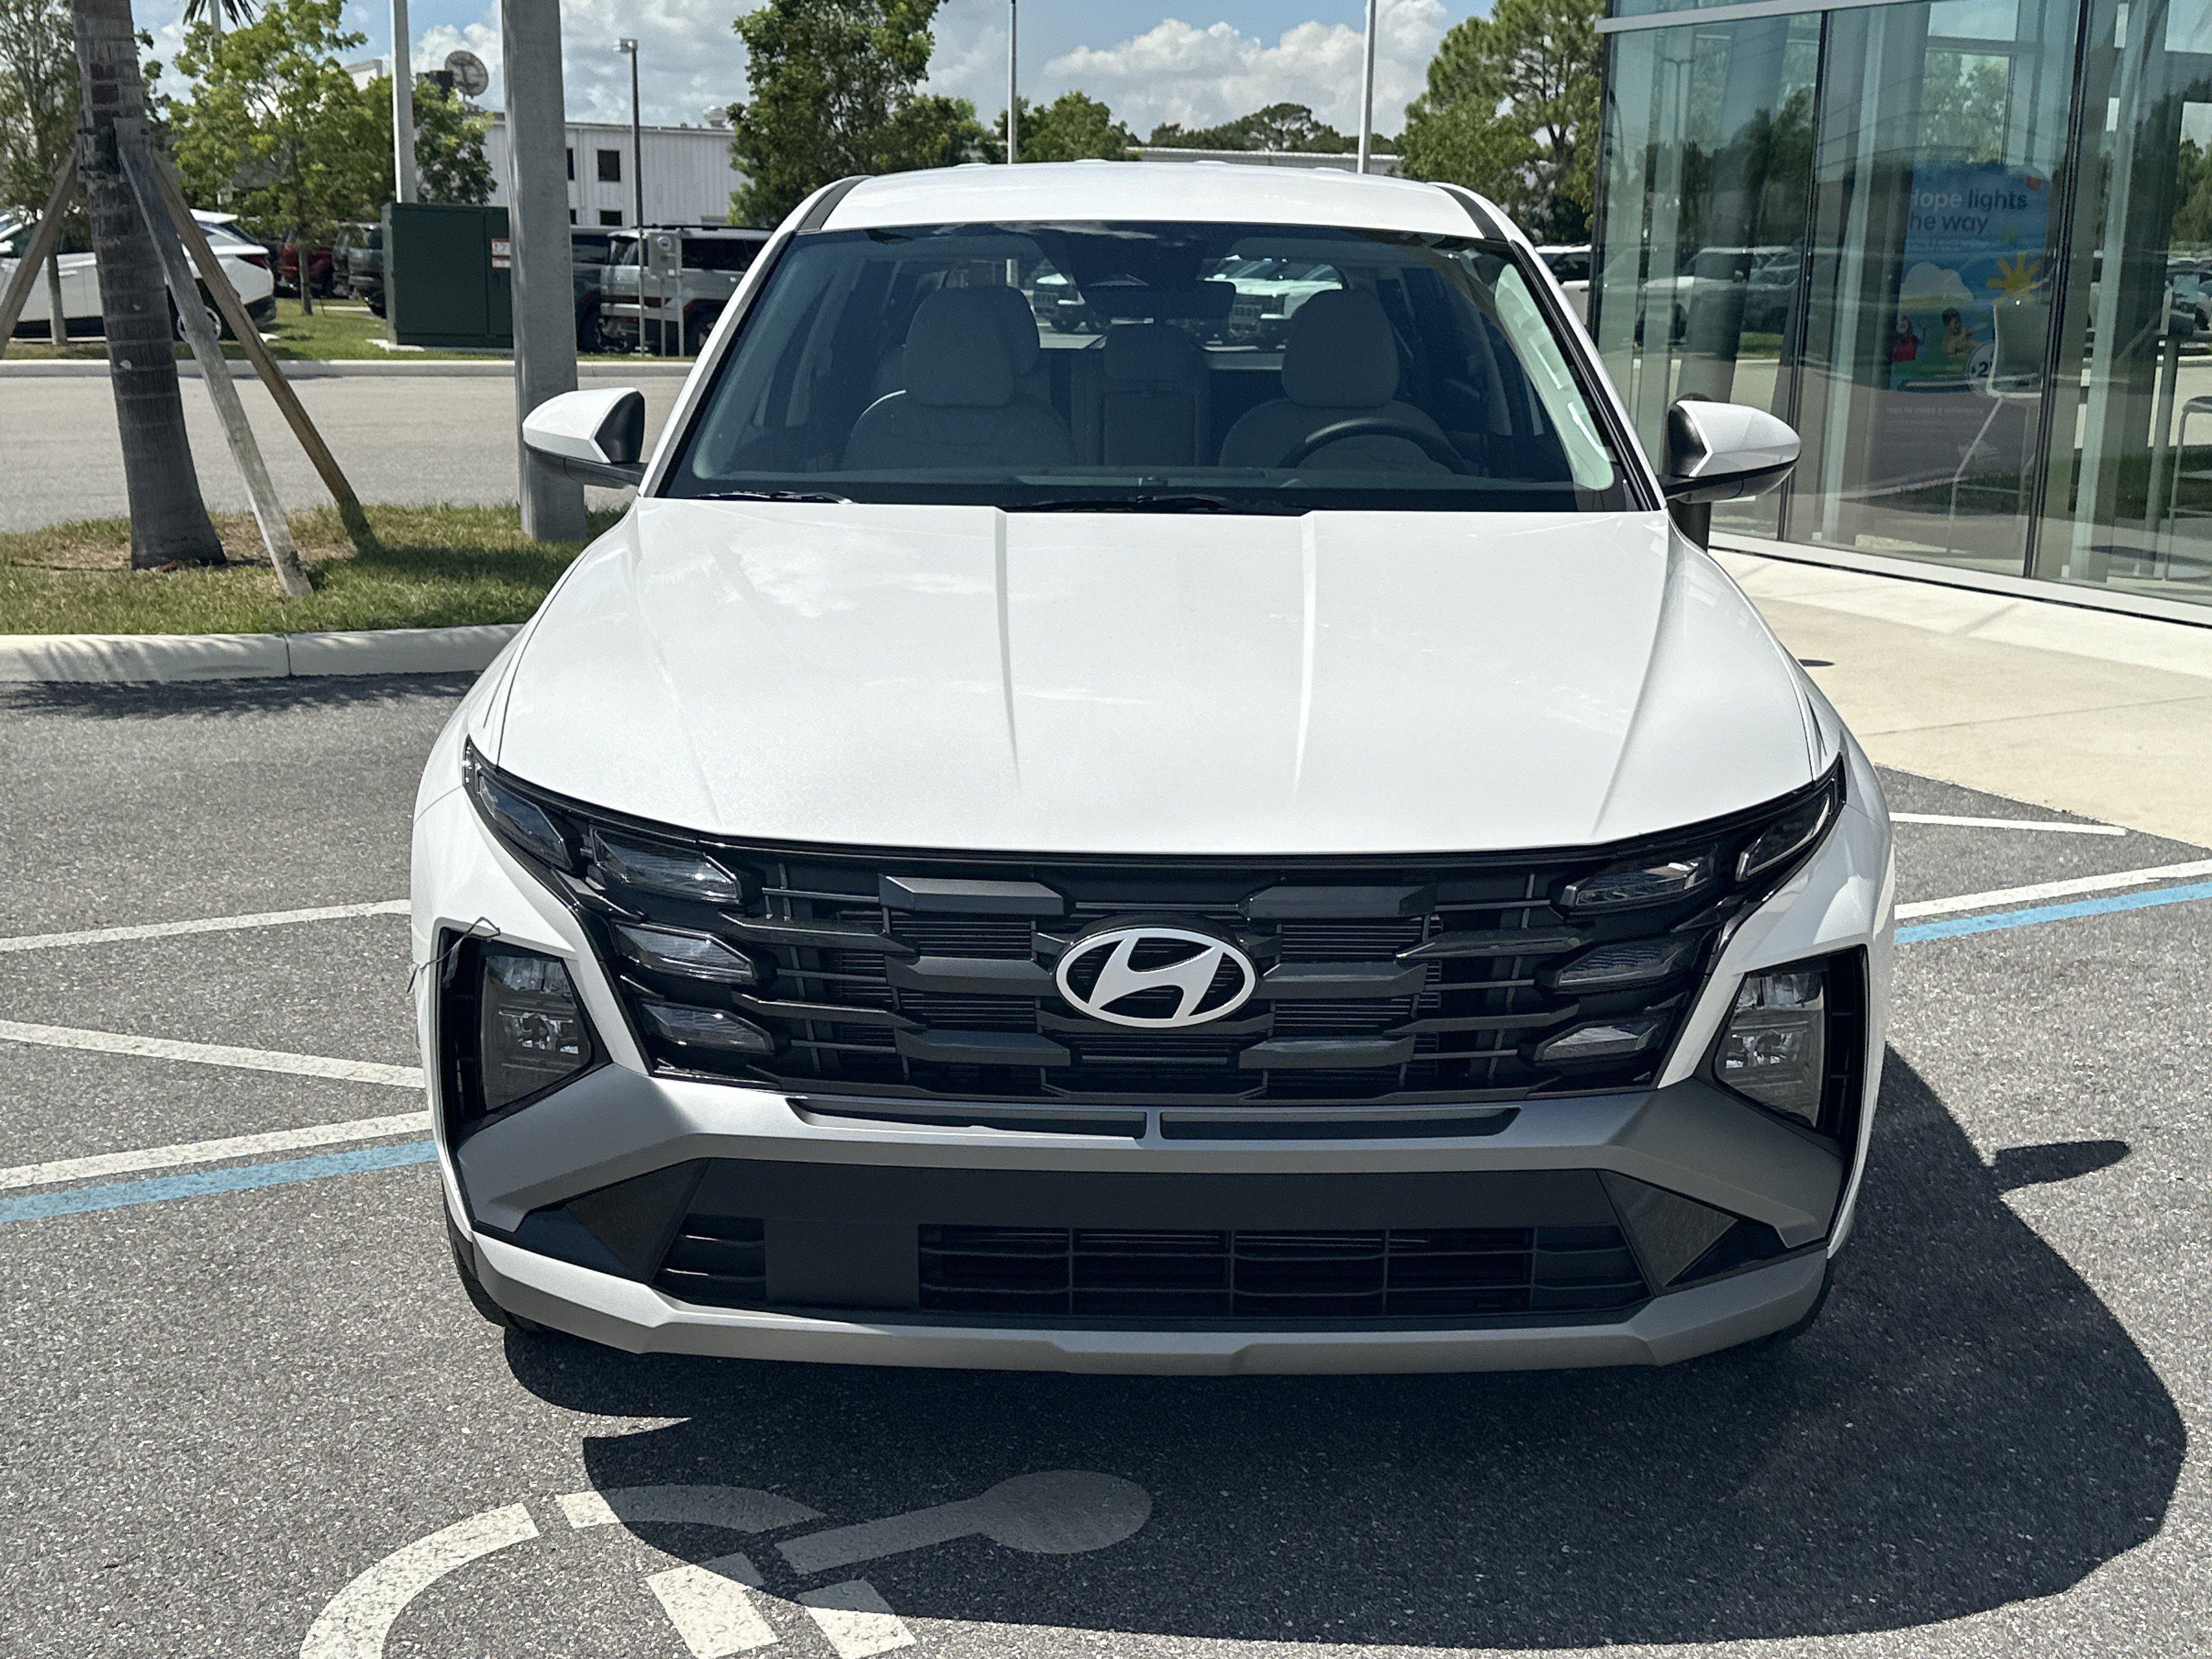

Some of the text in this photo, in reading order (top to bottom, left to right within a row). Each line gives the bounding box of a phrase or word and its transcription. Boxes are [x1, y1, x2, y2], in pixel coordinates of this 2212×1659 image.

[1968, 188, 2028, 211] lights
[1909, 211, 1990, 235] he way
